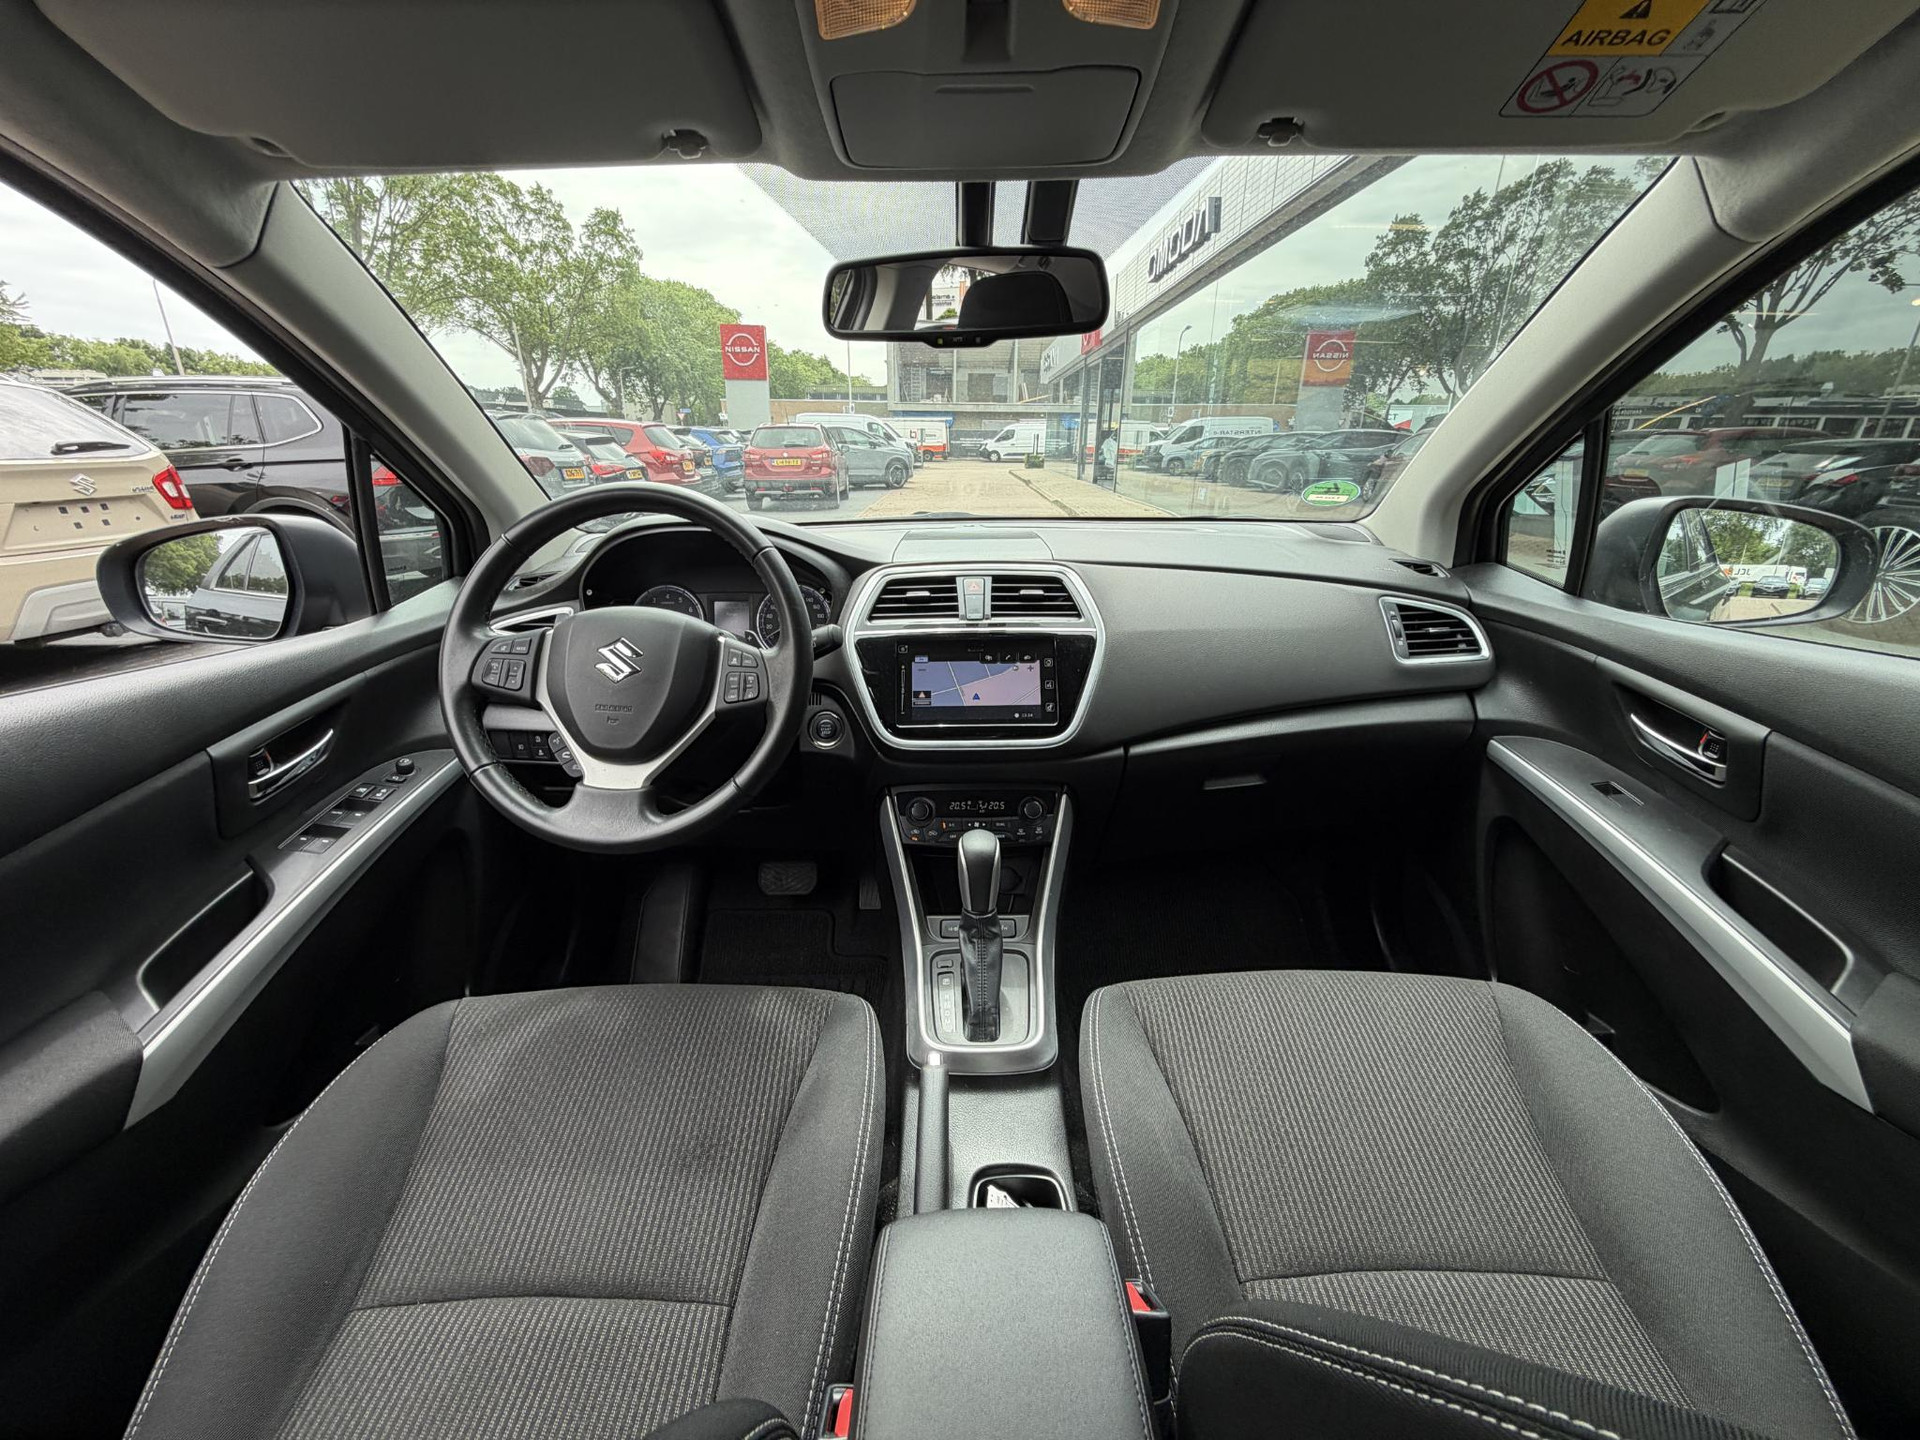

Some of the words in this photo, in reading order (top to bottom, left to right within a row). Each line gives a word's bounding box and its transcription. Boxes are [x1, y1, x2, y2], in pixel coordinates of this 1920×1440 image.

[1561, 29, 1671, 46] AIRBAG
[1147, 197, 1221, 283] OMODA
[949, 801, 966, 810] 20.5
[988, 801, 1005, 810] 20.5
